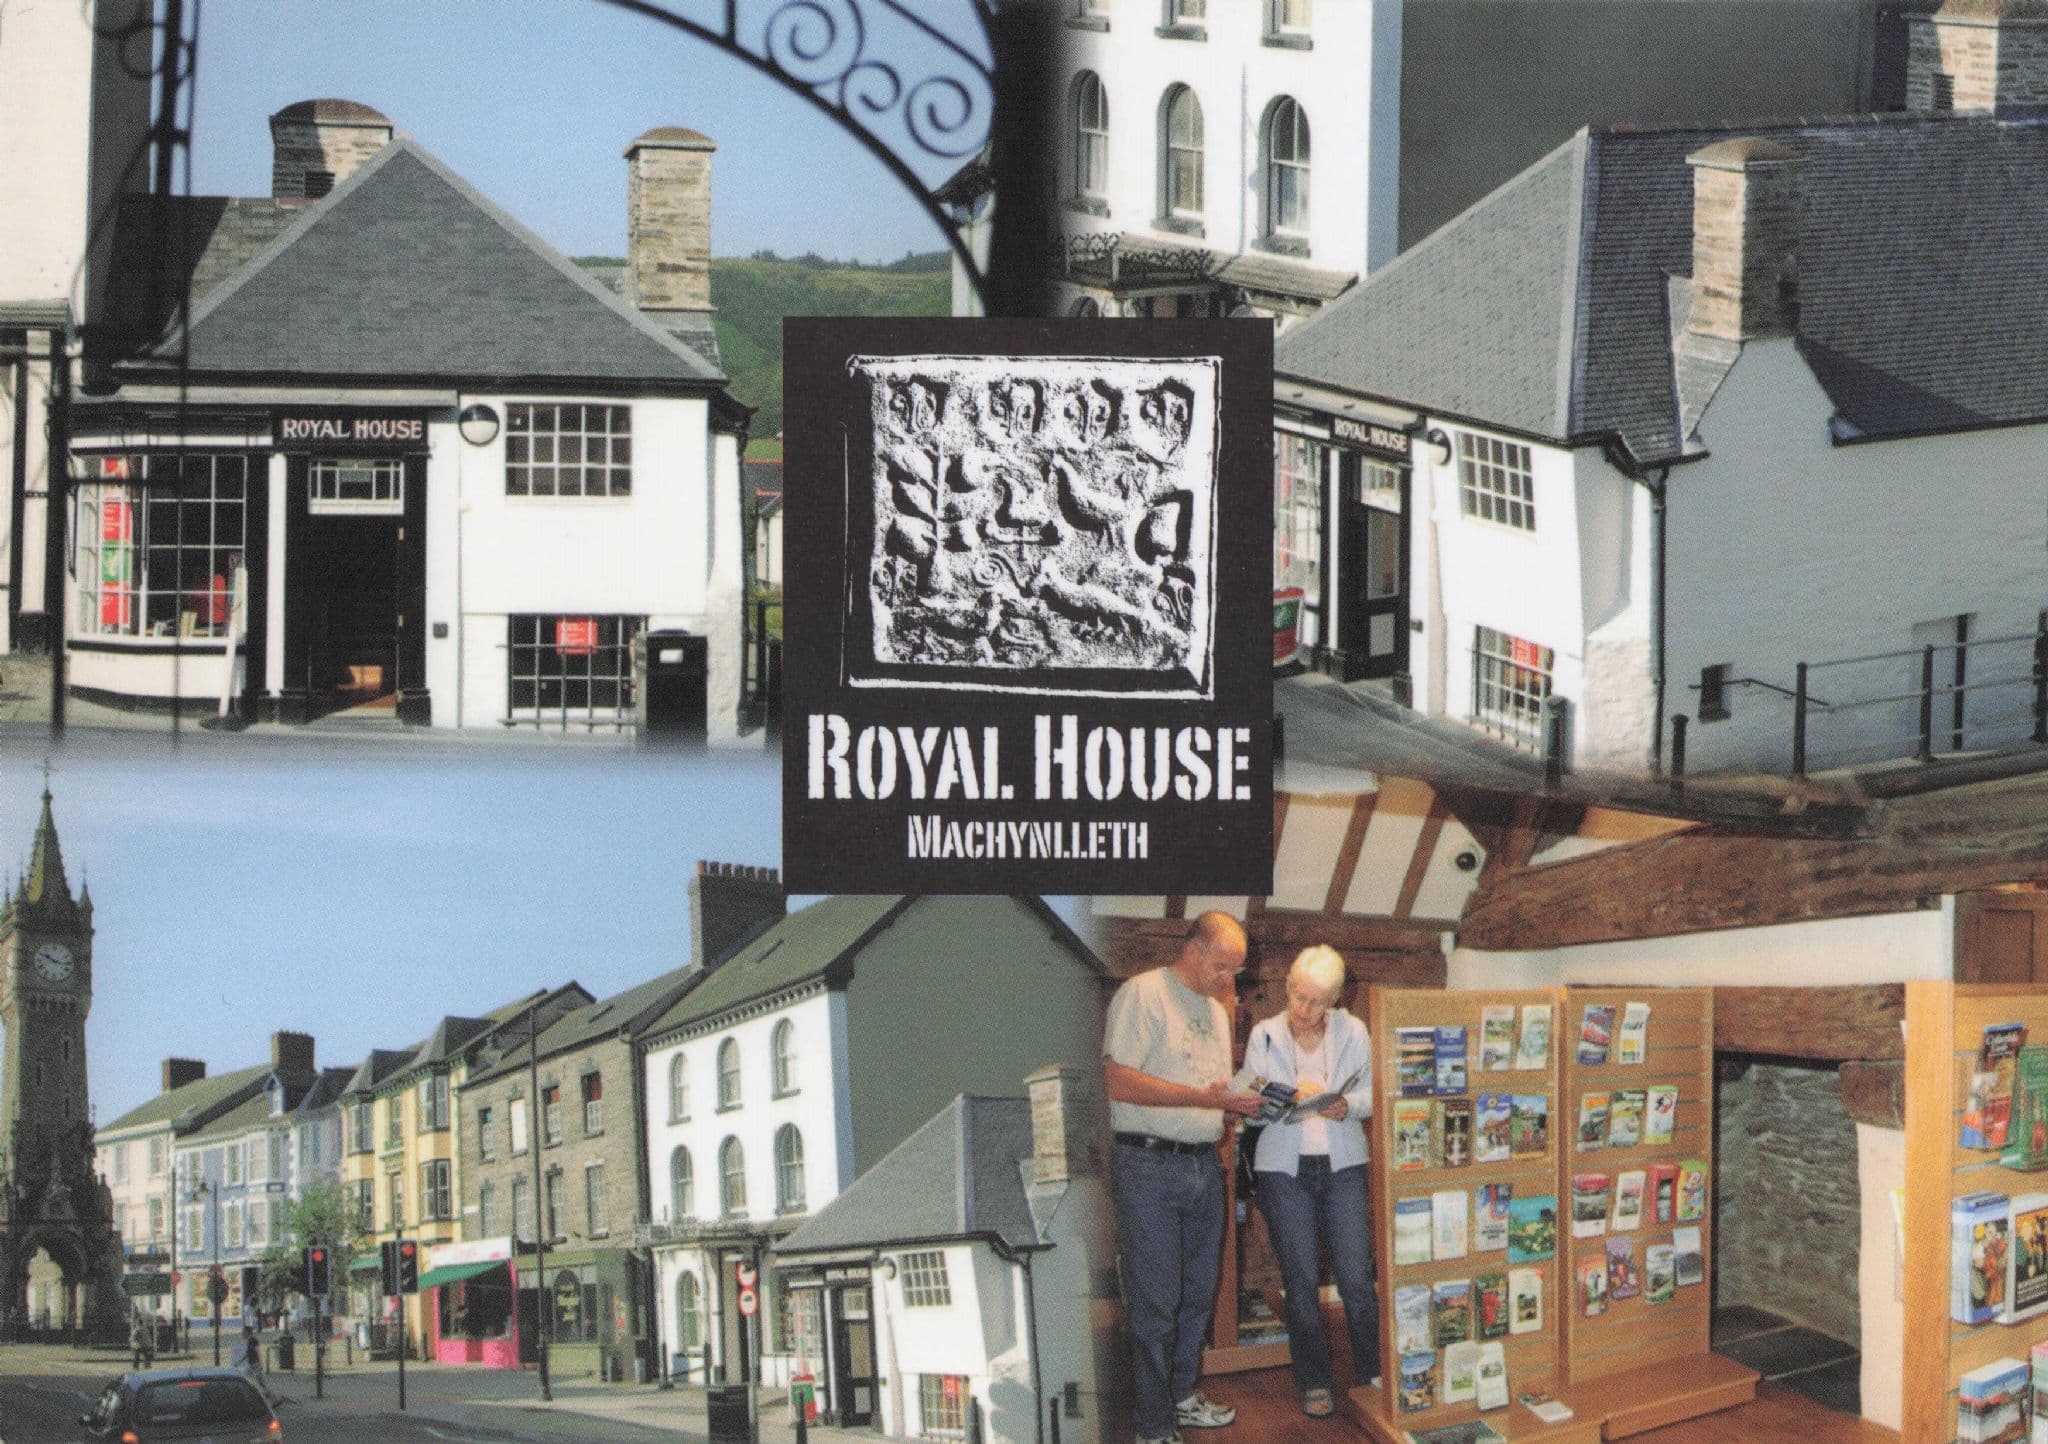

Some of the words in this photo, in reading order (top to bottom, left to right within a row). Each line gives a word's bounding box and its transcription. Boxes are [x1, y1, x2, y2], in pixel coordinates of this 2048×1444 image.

[282, 419, 350, 438] ROYAL
[354, 420, 422, 439] HOUSE
[1334, 417, 1369, 442] ROYAL
[1370, 426, 1407, 452] HOUSE
